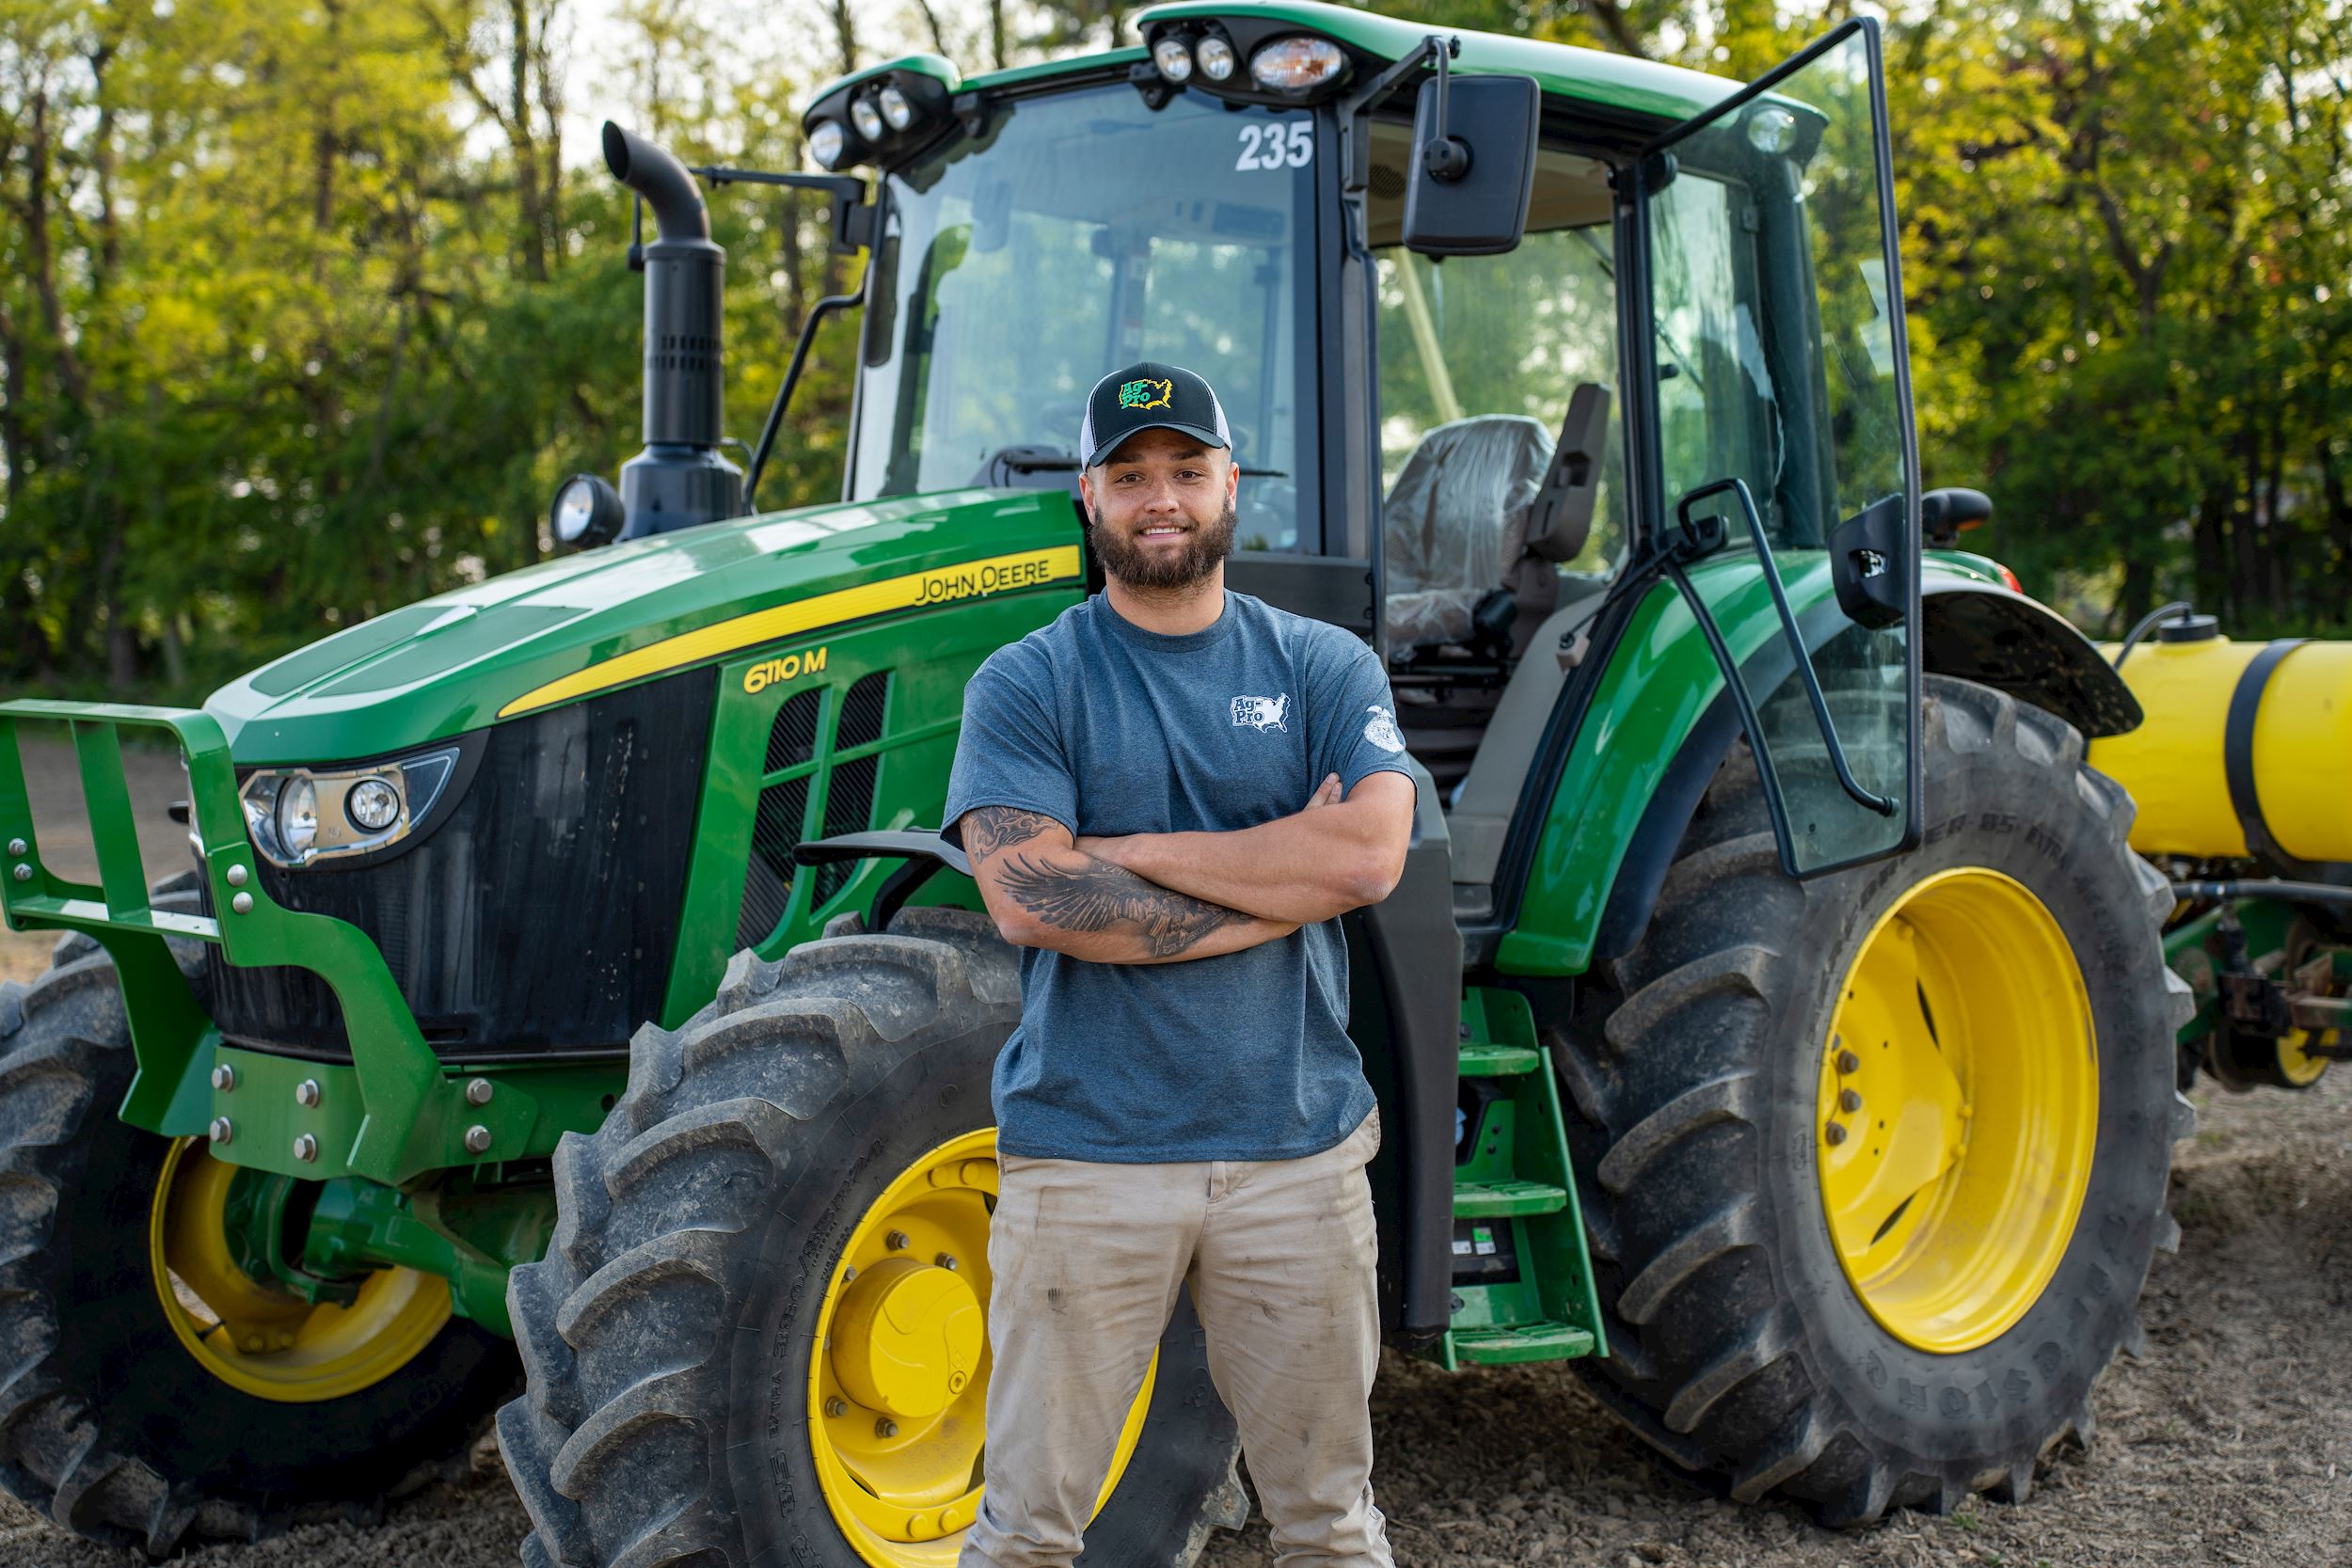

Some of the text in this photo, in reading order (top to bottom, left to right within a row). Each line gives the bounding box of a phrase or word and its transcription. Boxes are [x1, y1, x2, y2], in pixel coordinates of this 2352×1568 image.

[1235, 119, 1314, 171] 235
[1121, 391, 1151, 409] Pro
[914, 561, 1053, 606] JOHN DEERE
[1235, 710, 1263, 723] Pro
